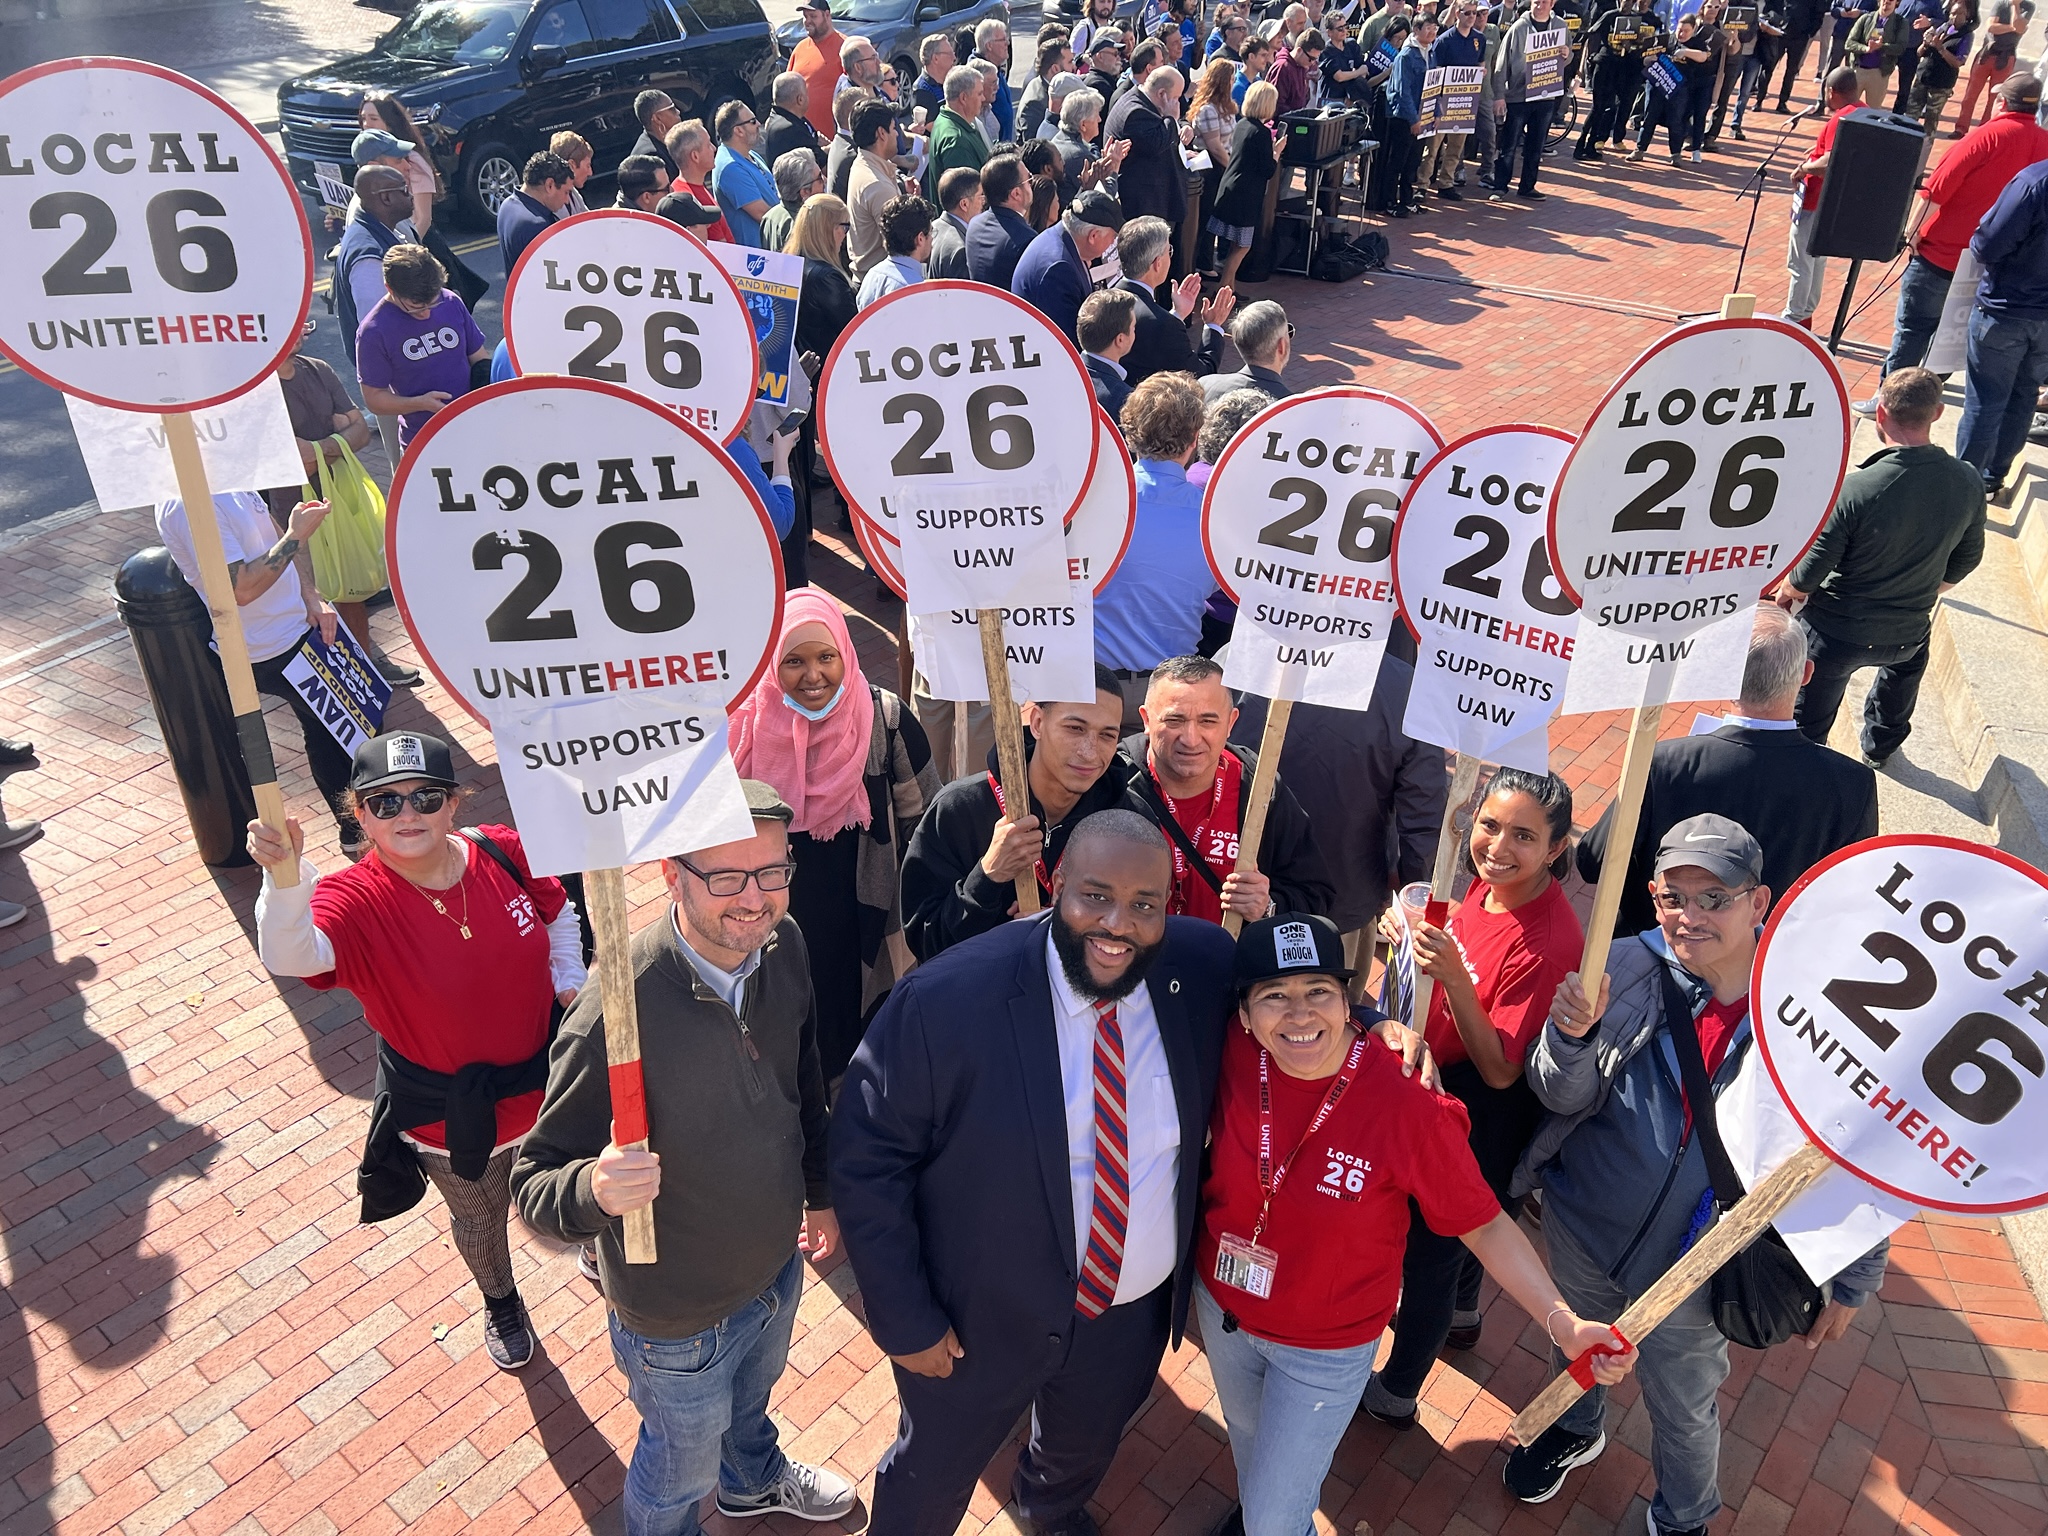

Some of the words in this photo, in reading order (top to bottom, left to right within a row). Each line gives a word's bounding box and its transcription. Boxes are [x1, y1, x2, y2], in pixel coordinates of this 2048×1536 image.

[1528, 51, 1552, 61] STAND
[1532, 31, 1560, 49] UAW
[1451, 68, 1479, 83] UAW
[1526, 76, 1563, 90] CONTRACTS
[1532, 59, 1558, 70] RECORD
[1532, 65, 1558, 76] PROFITS
[1532, 72, 1558, 83] RECORD
[1647, 66, 1673, 95] CONTRACT
[1652, 61, 1677, 90] STRONG
[0, 132, 239, 177] LOCAL
[28, 189, 239, 297] 26
[543, 260, 713, 305] LOCAL
[733, 277, 761, 291] TAND
[763, 281, 788, 296] WITH
[27, 313, 269, 352] UNITEHERE!
[402, 327, 460, 361] GEO
[564, 305, 702, 390] 26
[854, 335, 1042, 384] LOCAL
[1617, 382, 1814, 429] LOCAL
[882, 384, 1036, 477] 26
[1262, 431, 1421, 481] LOCAL
[431, 455, 700, 513] LOCAL
[1447, 465, 1546, 515] LOC
[1611, 435, 1786, 533] 26
[915, 505, 1044, 530] SUPPORTS
[1257, 476, 1402, 564] 26
[953, 547, 1014, 569] UAW
[1442, 514, 1582, 617] 26
[1584, 543, 1780, 580] UNITEHERE!
[472, 520, 696, 643] 26
[1233, 556, 1395, 604] UNITEHERE!
[951, 607, 1076, 627] SUPORTS
[1254, 603, 1373, 640] SUPPORTS
[1597, 593, 1739, 627] SUPPORTS
[1420, 596, 1575, 662] UNITEHERE
[308, 650, 327, 676] UP
[335, 640, 373, 687] NOW
[1005, 646, 1045, 665] AW
[1276, 645, 1335, 669] UAW
[1626, 639, 1695, 665] UAW
[326, 651, 367, 706] COLA
[349, 665, 383, 711] FAIR
[472, 649, 729, 700] UNITEHERE!
[1433, 649, 1554, 702] SUPPORTS
[297, 674, 357, 748] UAW
[329, 678, 372, 732] STAND
[1457, 694, 1516, 728] UAW
[392, 737, 417, 746] ONE
[521, 717, 706, 770] SUPPORTS
[392, 754, 421, 767] ENOUGH
[581, 776, 670, 815] UAW
[1209, 838, 1240, 859] 26
[1210, 829, 1238, 841] LOCA
[1279, 924, 1307, 935] ONE
[1283, 932, 1306, 940] JOB
[1874, 861, 2048, 1028] LOCA
[1282, 946, 1314, 962] ENOUGH
[1822, 931, 2047, 1125] 26
[1776, 994, 1990, 1188] UNITEHERE!
[1323, 1161, 1366, 1193] 26
[1326, 1147, 1372, 1172] LOCAL
